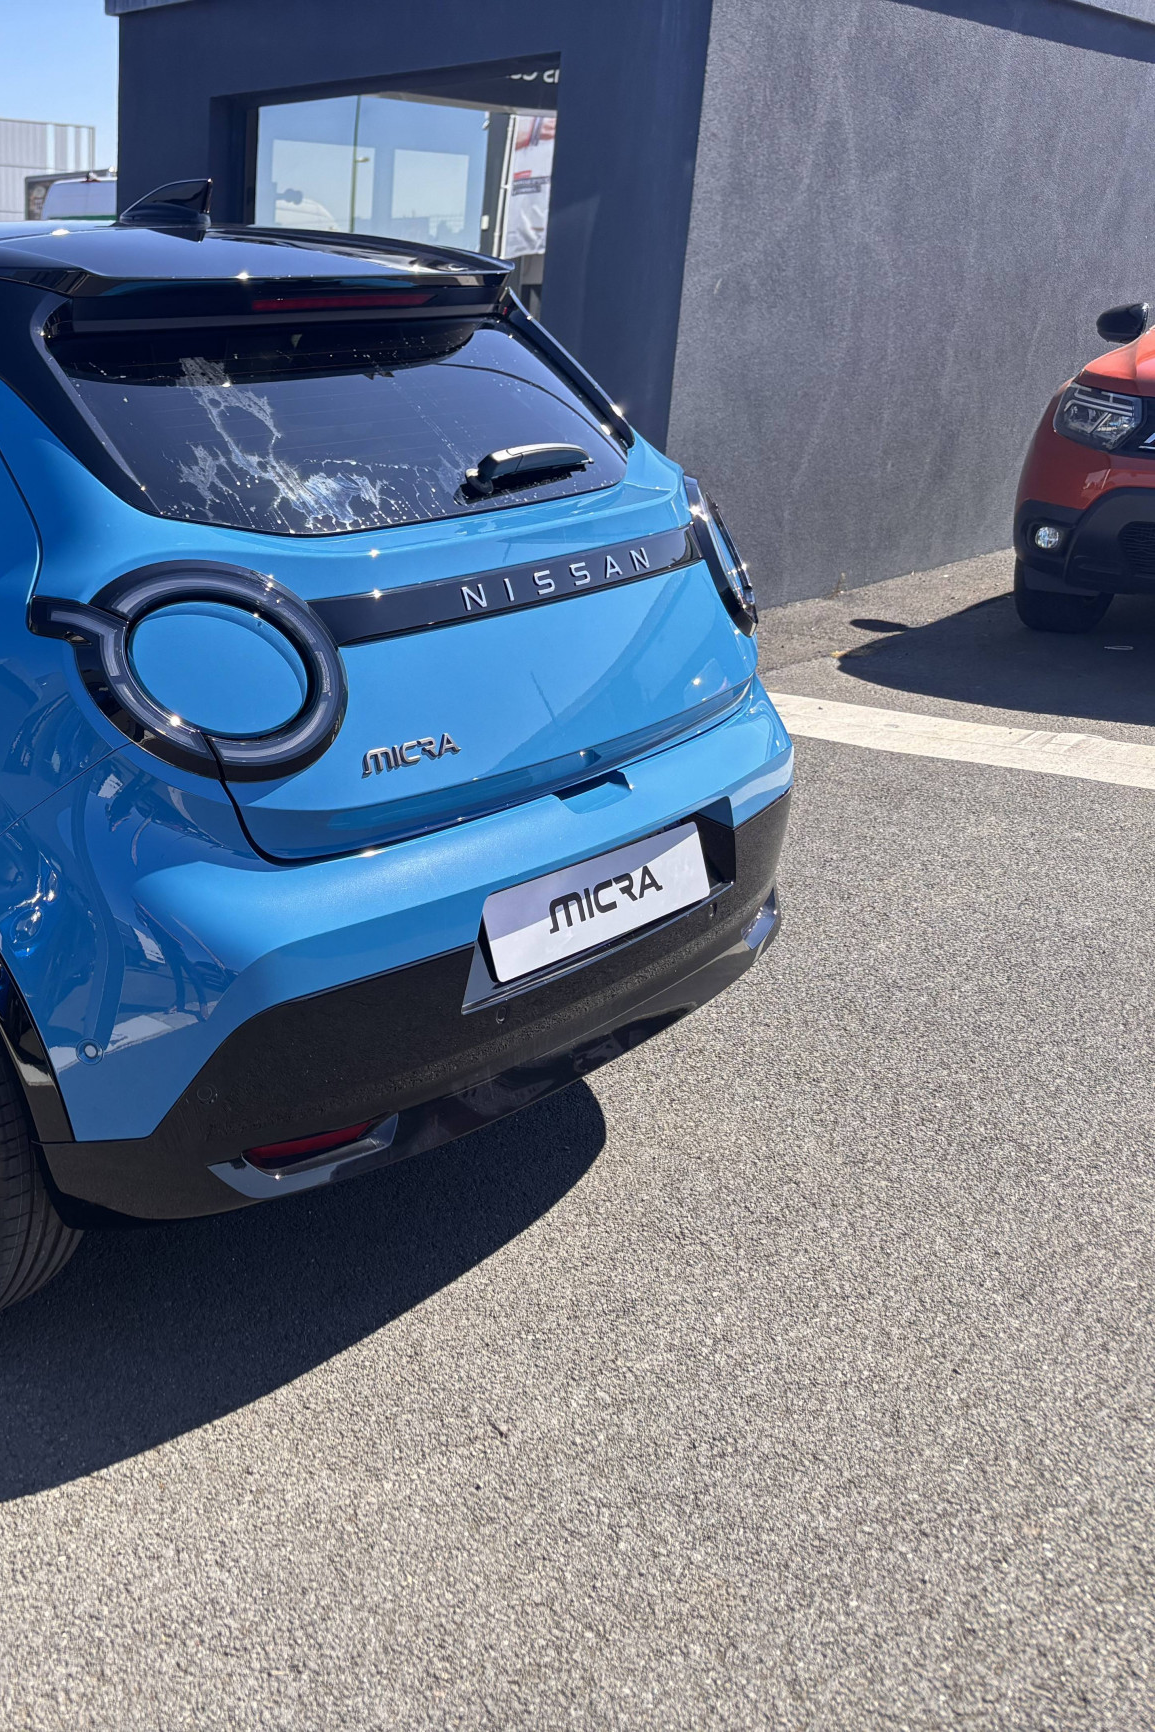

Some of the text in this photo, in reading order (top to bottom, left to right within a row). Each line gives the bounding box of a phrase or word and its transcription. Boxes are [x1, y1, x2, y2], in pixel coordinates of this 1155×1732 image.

[461, 547, 651, 611] NISSAN
[362, 733, 462, 778] MICRA
[549, 865, 664, 934] MICRA
